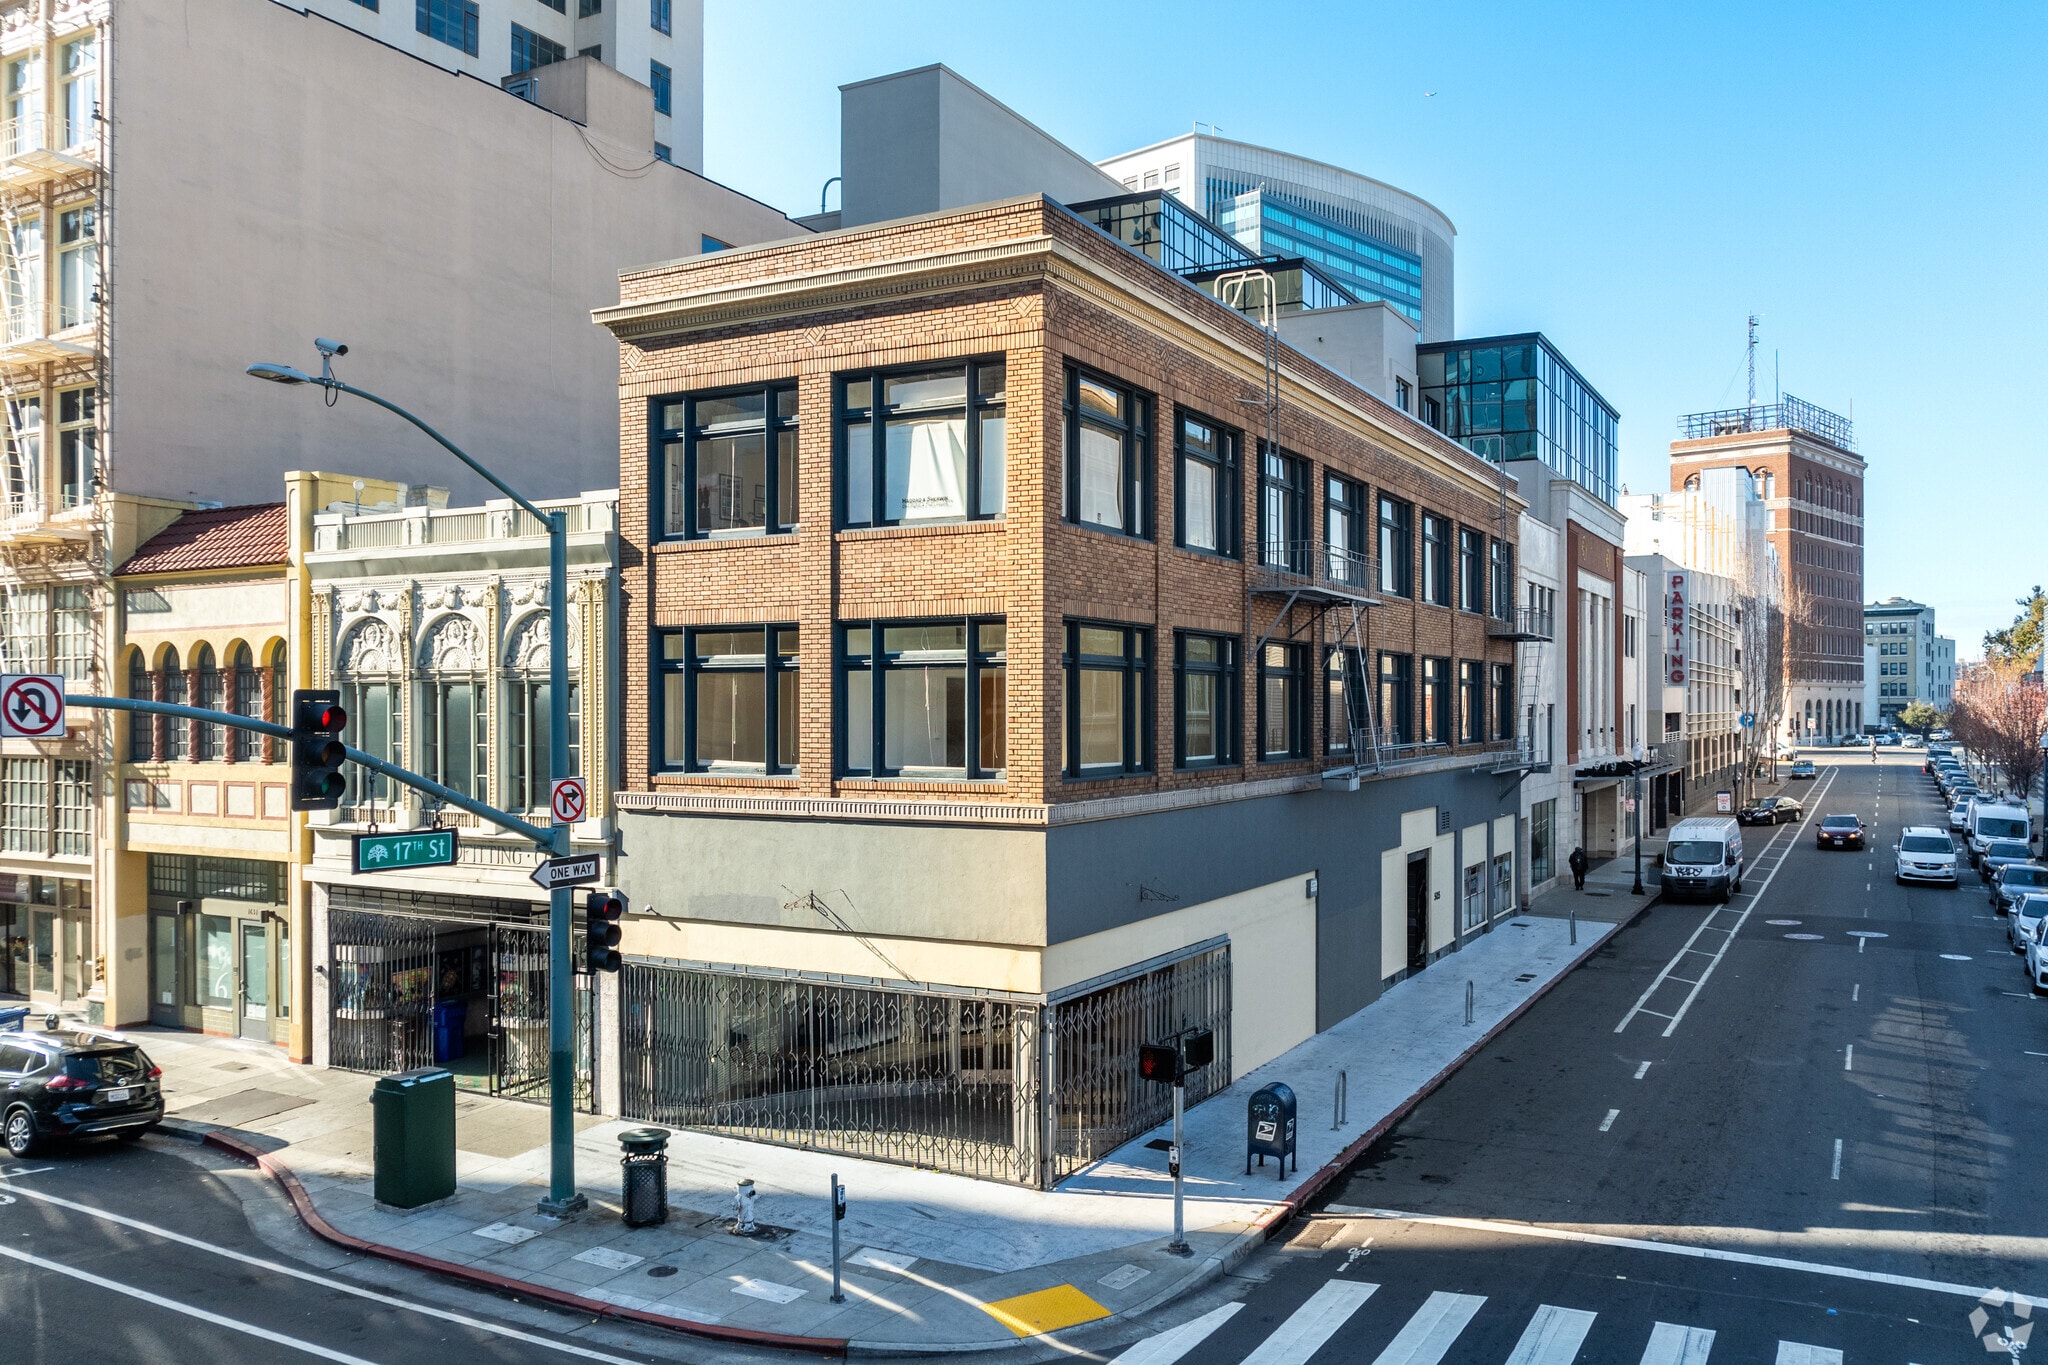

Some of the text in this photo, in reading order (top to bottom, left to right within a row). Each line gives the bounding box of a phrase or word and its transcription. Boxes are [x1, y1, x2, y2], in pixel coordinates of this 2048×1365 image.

[1670, 575, 1685, 684] PARKING
[393, 839, 445, 861] 17TH St
[463, 844, 523, 865] FITTING
[551, 863, 593, 879] ONE WAY
